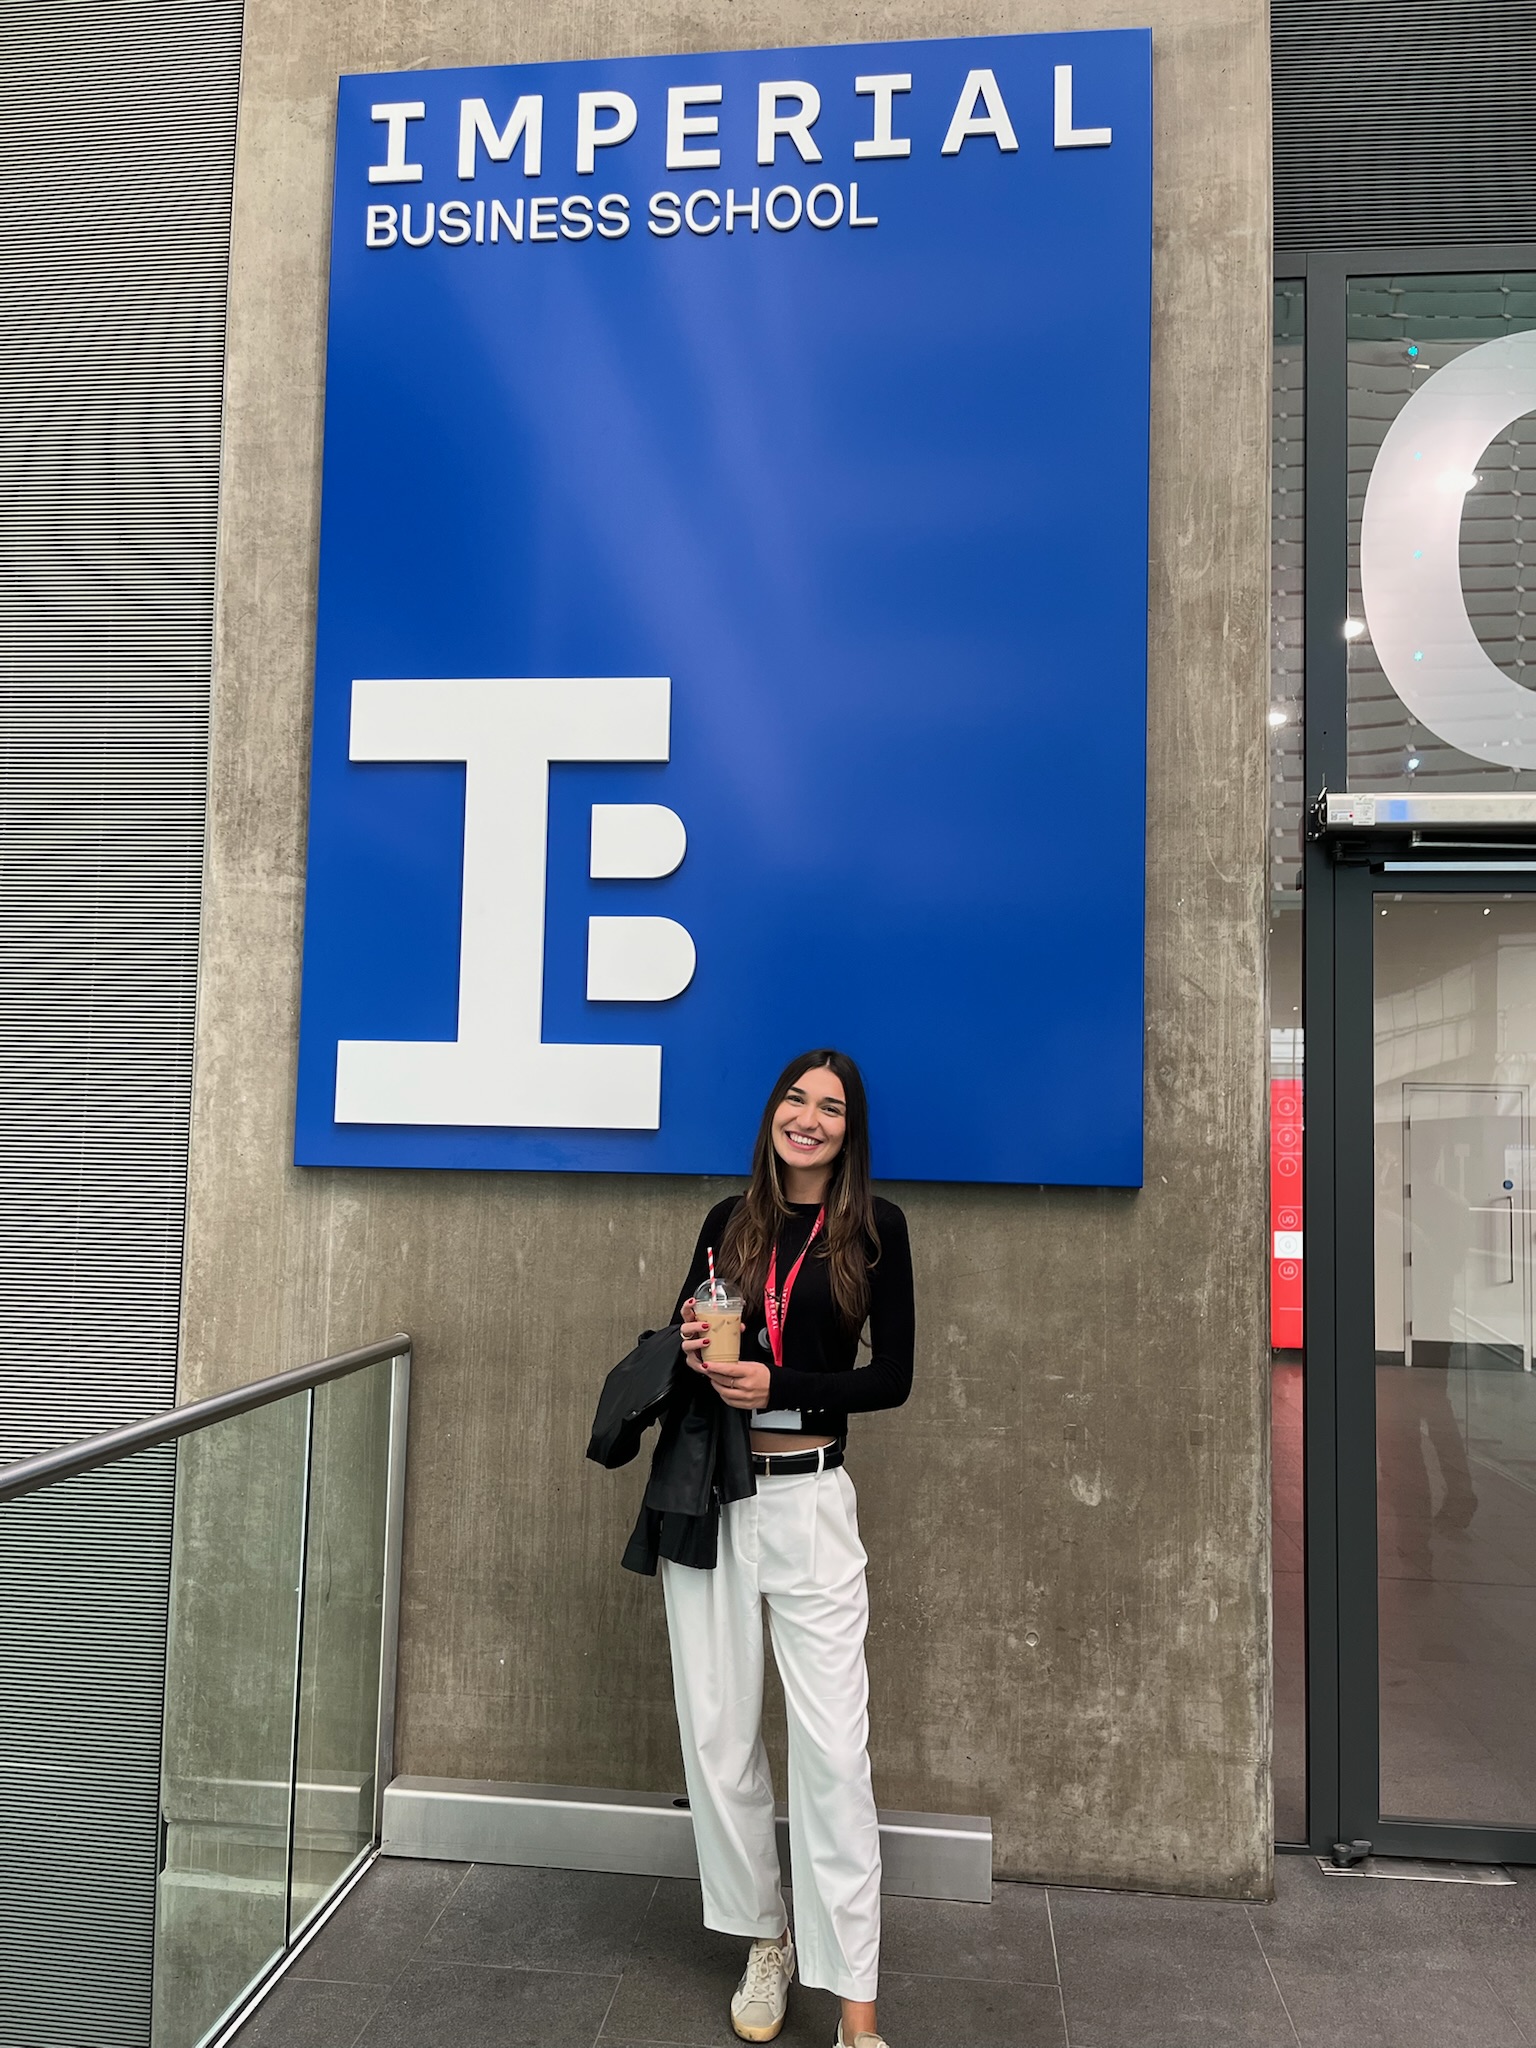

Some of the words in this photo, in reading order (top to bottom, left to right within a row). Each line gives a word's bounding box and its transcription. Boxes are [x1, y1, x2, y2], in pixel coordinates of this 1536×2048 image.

[368, 64, 1113, 183] IMPERIAL
[365, 193, 631, 248] BUSINESS
[648, 182, 879, 238] SCHOOL
[1283, 1102, 1290, 1111] 3
[1284, 1133, 1291, 1142] 2
[1281, 1215, 1295, 1225] UG
[1282, 1266, 1295, 1275] LG
